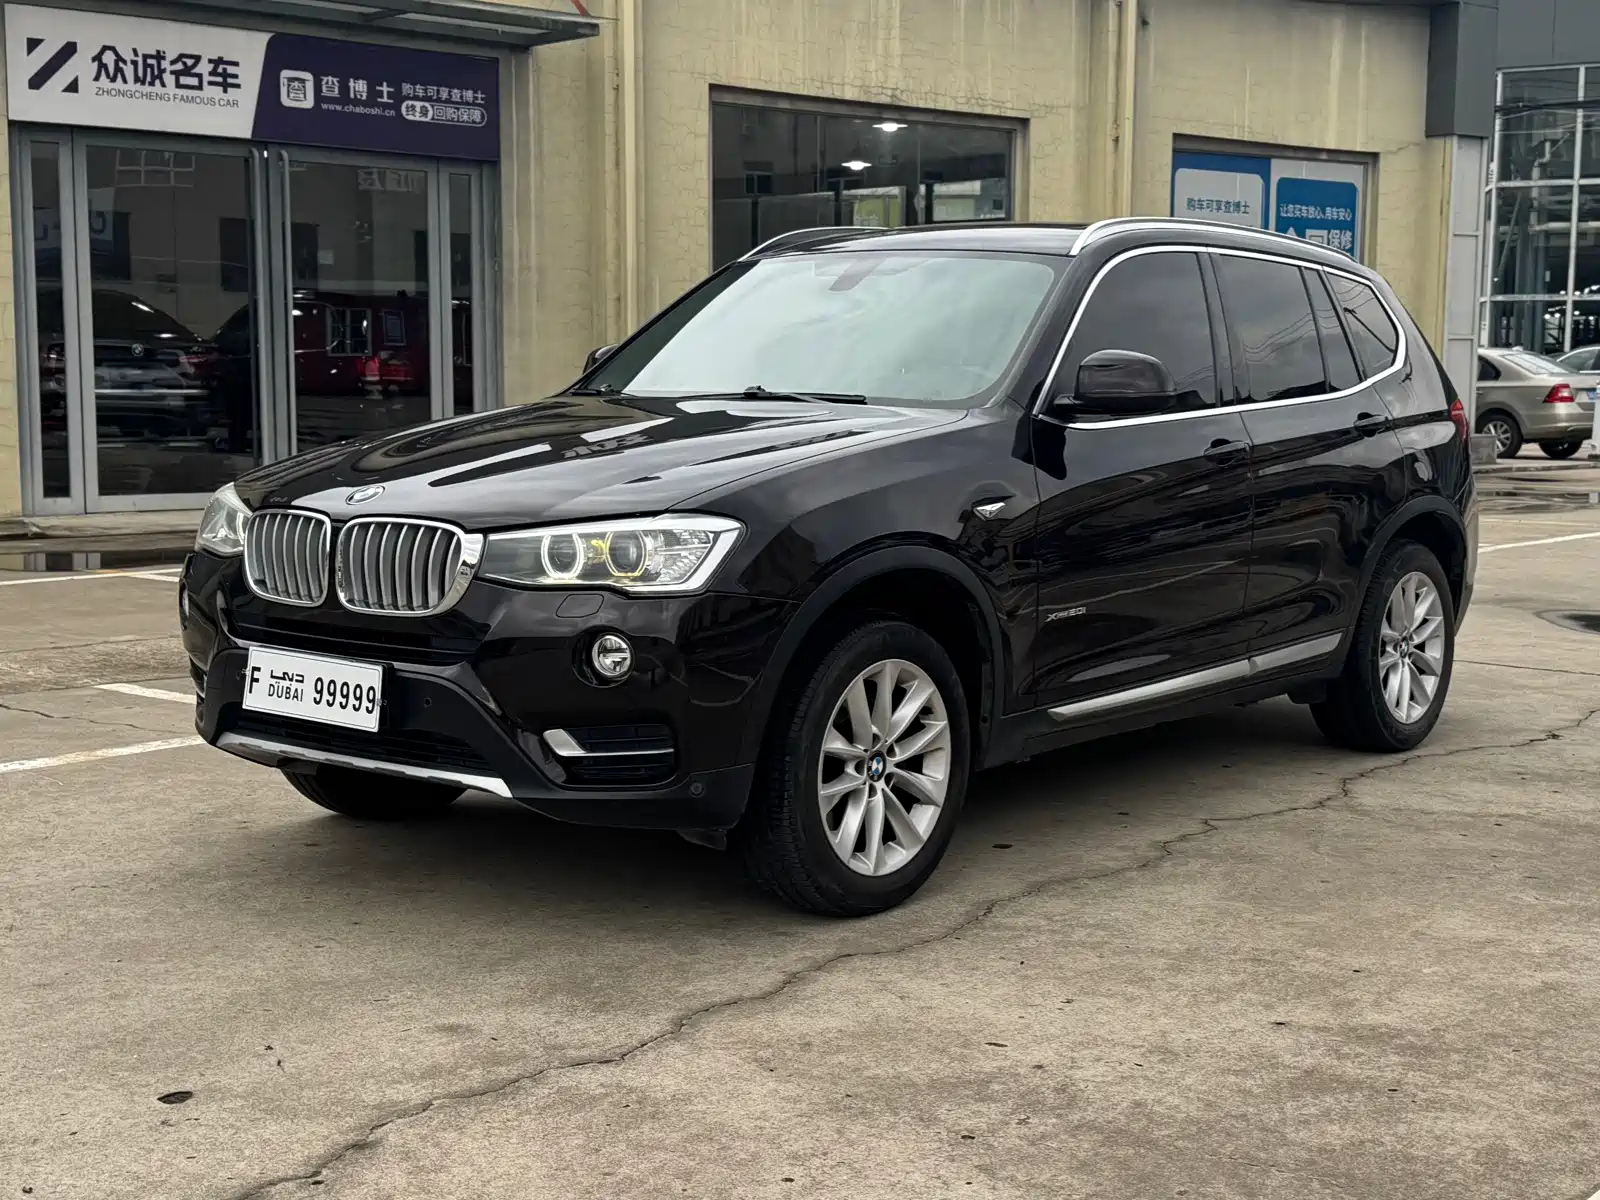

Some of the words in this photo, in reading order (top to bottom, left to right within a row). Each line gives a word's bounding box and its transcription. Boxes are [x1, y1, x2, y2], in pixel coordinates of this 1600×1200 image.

[91, 44, 242, 94] 众诚名车
[95, 86, 171, 102] ZHONGCHENG
[172, 93, 217, 107] FAMOUS
[218, 98, 240, 109] CAR
[320, 76, 395, 103] 查博士
[401, 82, 487, 104] 购车可享查博士
[320, 102, 396, 117] www.chaboshi.cn
[1186, 197, 1250, 215] 购车可享查博士
[249, 666, 262, 694] F
[268, 683, 304, 703] DUBAI
[313, 676, 377, 714] 99999
